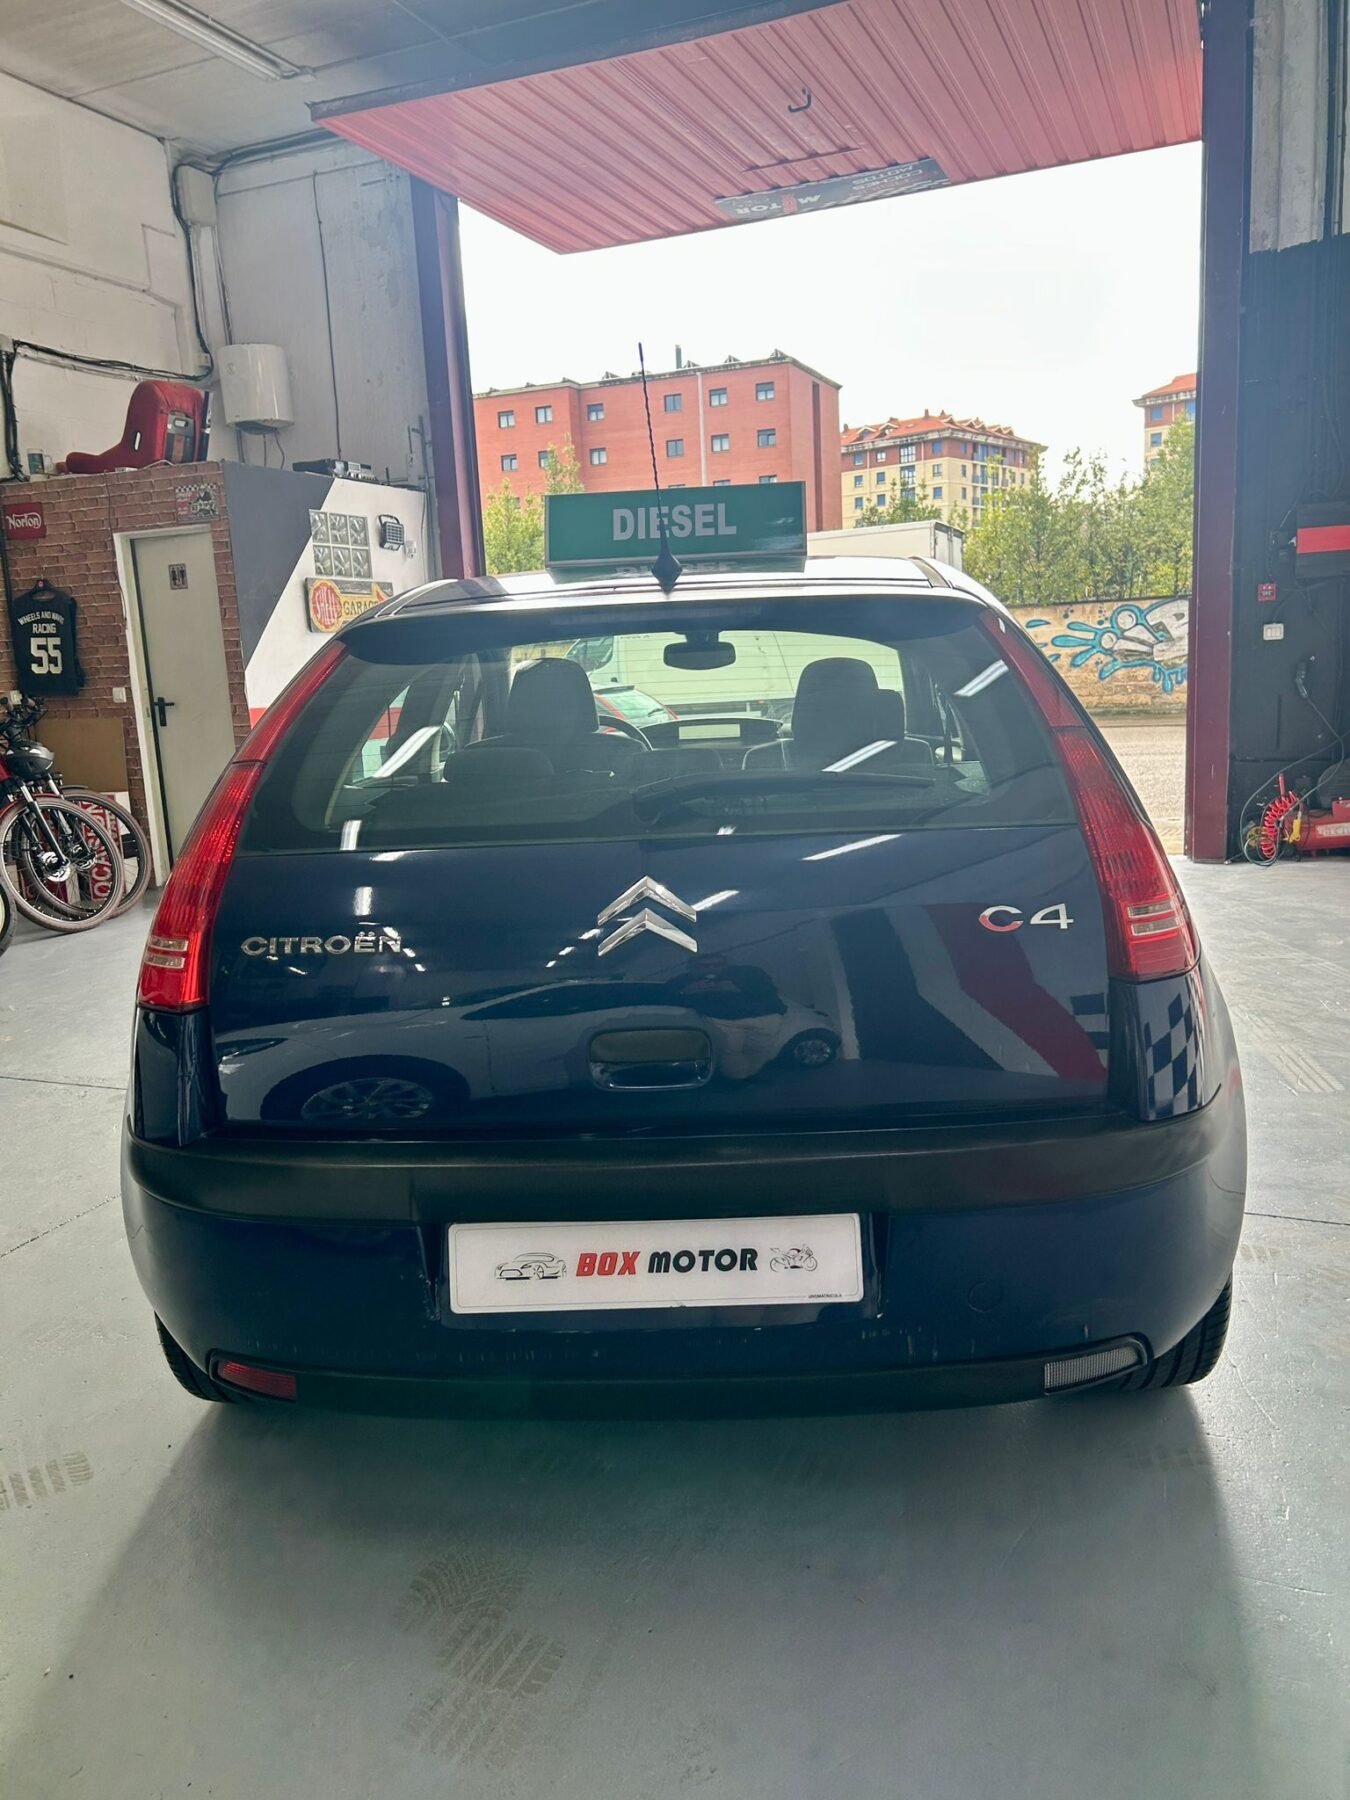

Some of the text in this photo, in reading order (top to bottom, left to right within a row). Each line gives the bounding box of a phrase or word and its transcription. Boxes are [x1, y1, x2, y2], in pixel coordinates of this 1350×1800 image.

[5, 511, 42, 530] Norton
[612, 503, 737, 541] DIESEL
[32, 623, 57, 634] RACING
[30, 637, 63, 674] 55
[978, 903, 1075, 932] C4
[240, 931, 402, 957] CITROËN
[575, 1247, 759, 1277] BOX MOTOR
